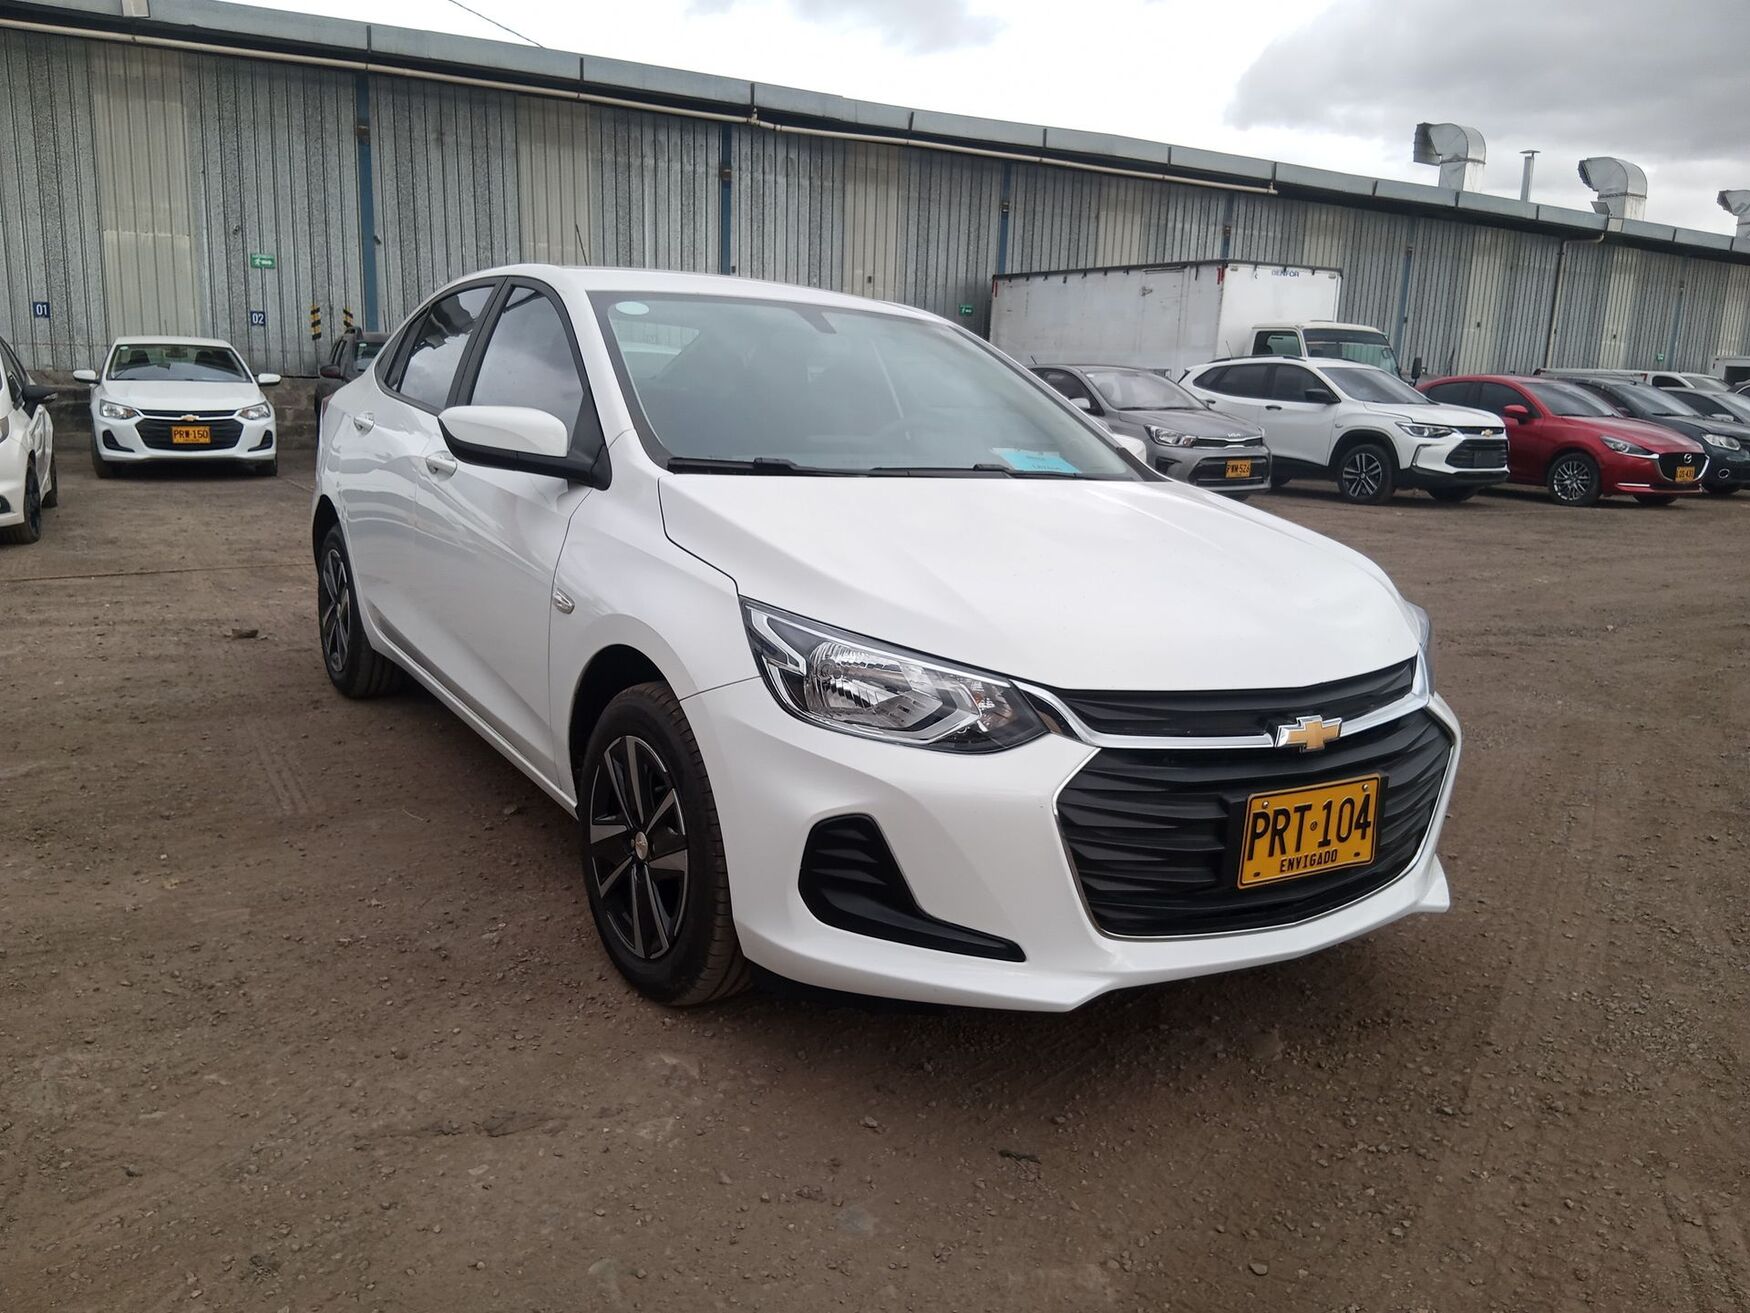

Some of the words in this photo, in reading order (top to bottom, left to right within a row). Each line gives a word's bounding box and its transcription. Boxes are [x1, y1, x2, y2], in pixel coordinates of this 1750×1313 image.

[36, 303, 48, 315] 01
[252, 312, 263, 323] 02
[1279, 849, 1338, 873] ENVIGADO
